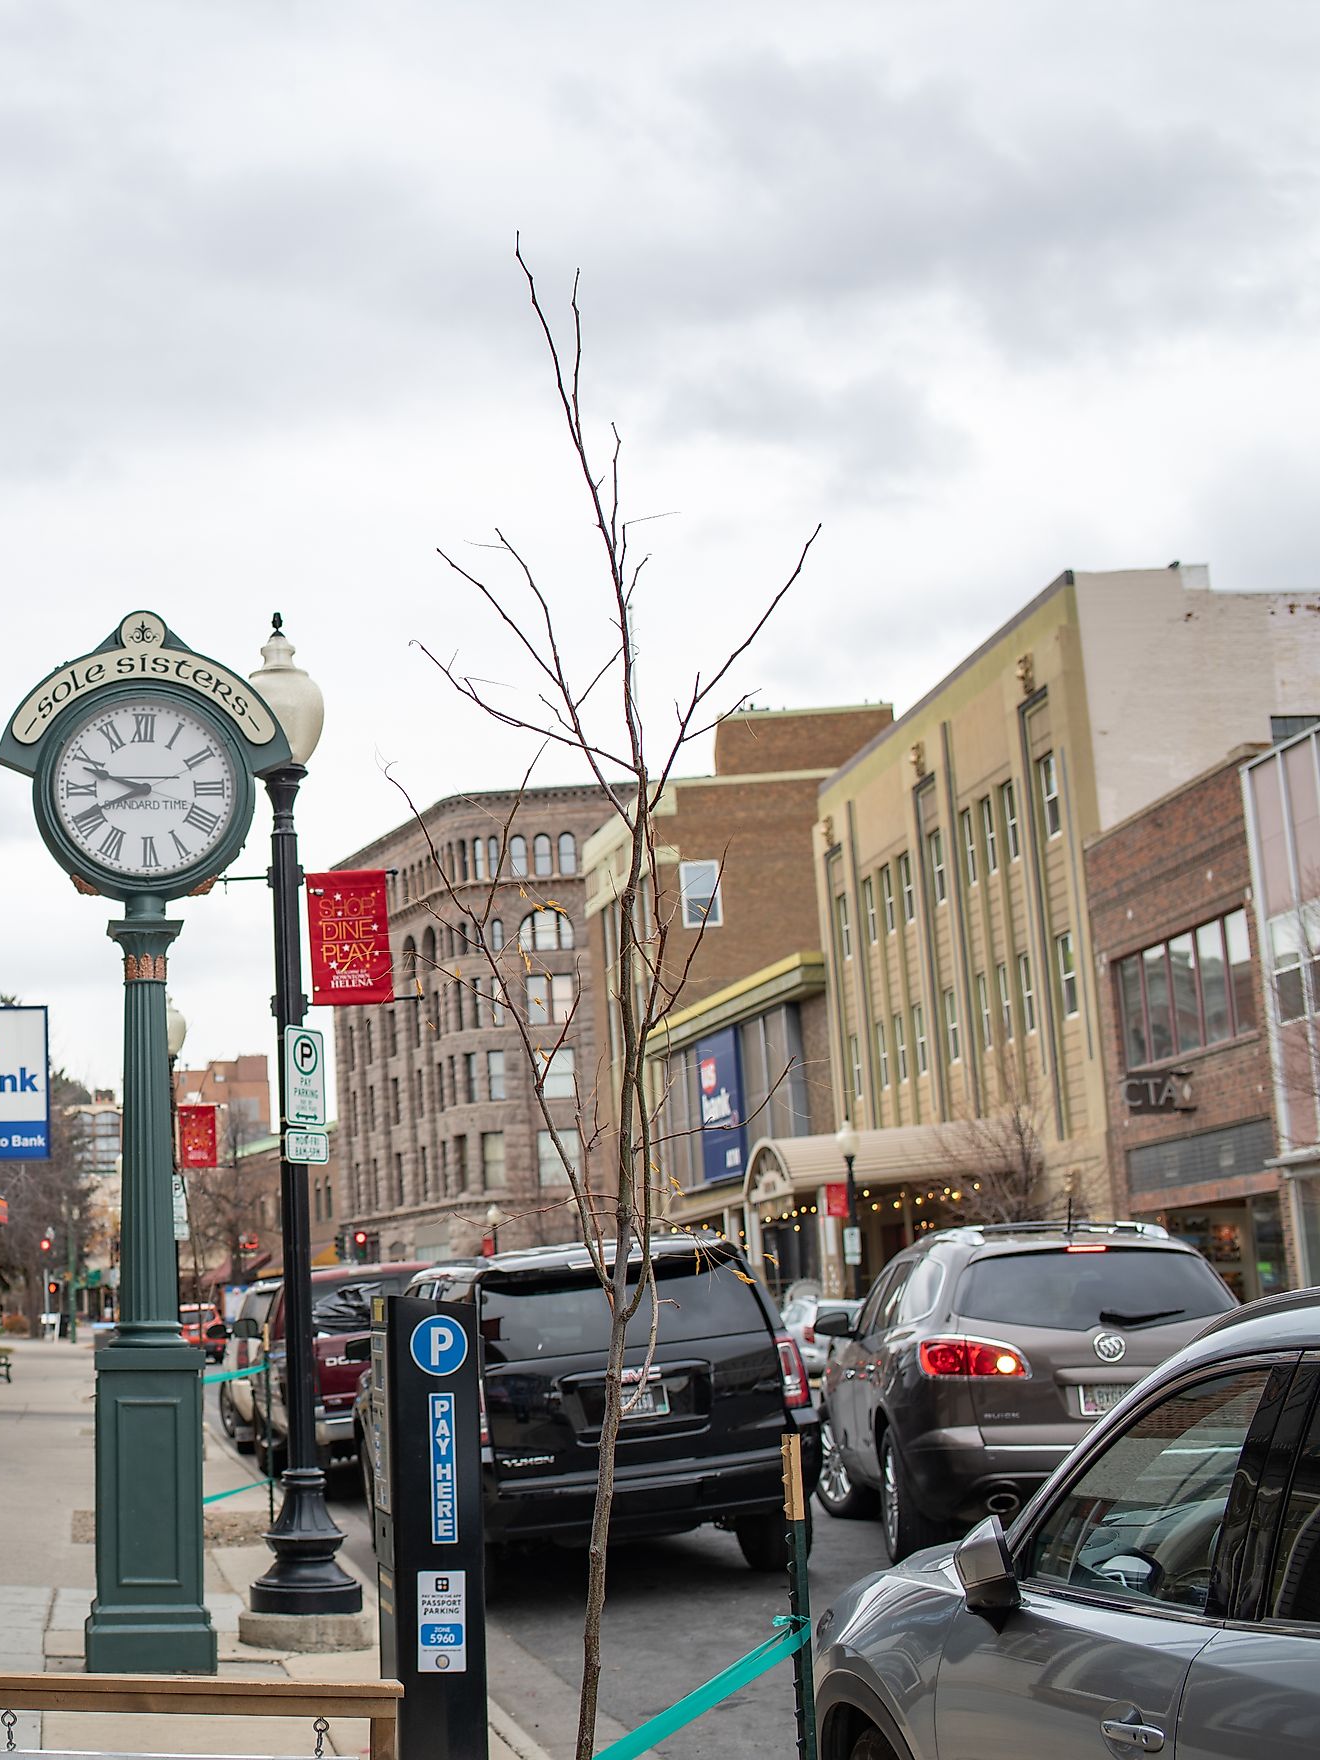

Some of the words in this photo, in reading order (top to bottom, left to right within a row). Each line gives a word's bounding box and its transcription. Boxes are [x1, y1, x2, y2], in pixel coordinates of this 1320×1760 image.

[104, 800, 160, 811] STANDARD
[162, 800, 188, 810] TIME
[320, 897, 375, 918] SHOP
[322, 920, 374, 941] DINE
[322, 942, 375, 963] PLAY
[331, 979, 373, 988] HELENA
[332, 973, 370, 981] DOWNTOWN
[300, 1043, 311, 1068] P
[300, 1077, 311, 1087] PAY
[294, 1087, 318, 1099] PARKING
[1121, 1079, 1178, 1106] CTA
[12, 1134, 46, 1148] Bank
[430, 1326, 454, 1366] P
[435, 1400, 451, 1455] PAY
[436, 1463, 453, 1537] HERE
[423, 1608, 460, 1616] PARKING
[430, 1633, 455, 1644] 5960
